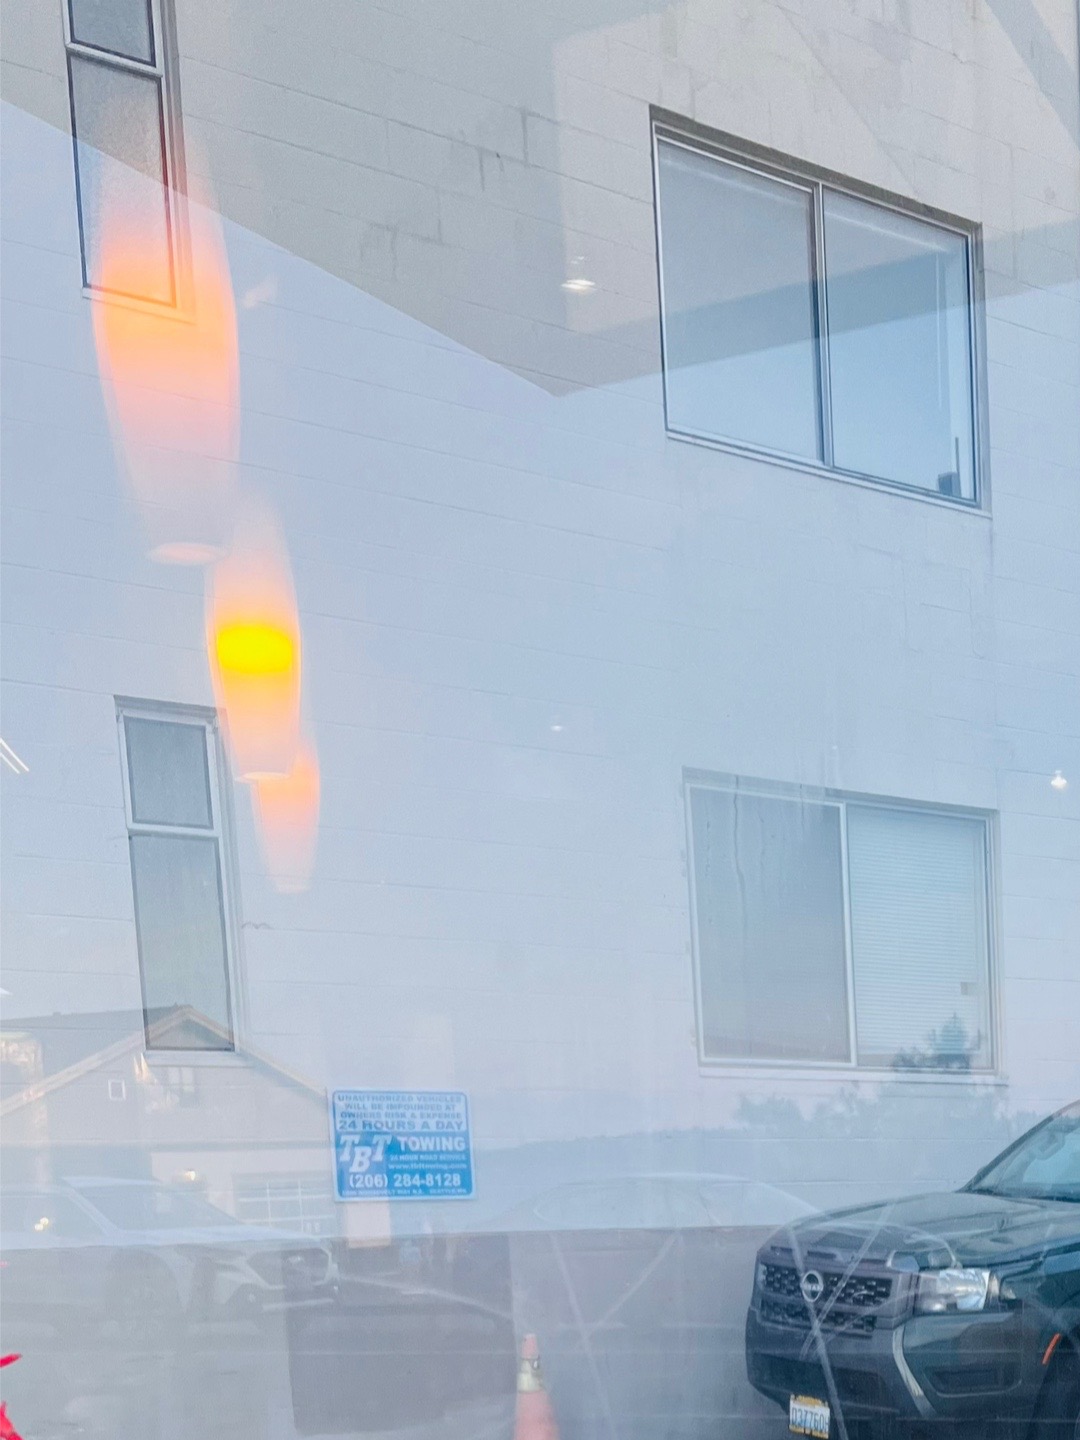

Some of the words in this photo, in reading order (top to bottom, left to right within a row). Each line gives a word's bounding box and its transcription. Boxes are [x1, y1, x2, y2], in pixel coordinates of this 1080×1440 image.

[338, 1094, 413, 1102] UNAUTHORIZED
[416, 1095, 462, 1103] VEHICLES
[386, 1103, 443, 1111] IMPOUNDED
[339, 1120, 357, 1130] 24
[362, 1120, 416, 1130] HOURS
[421, 1121, 431, 1130] A
[435, 1121, 463, 1130] DAY
[396, 1136, 465, 1152] TOWING
[349, 1174, 388, 1188] (206)
[394, 1173, 461, 1187] 284-8128
